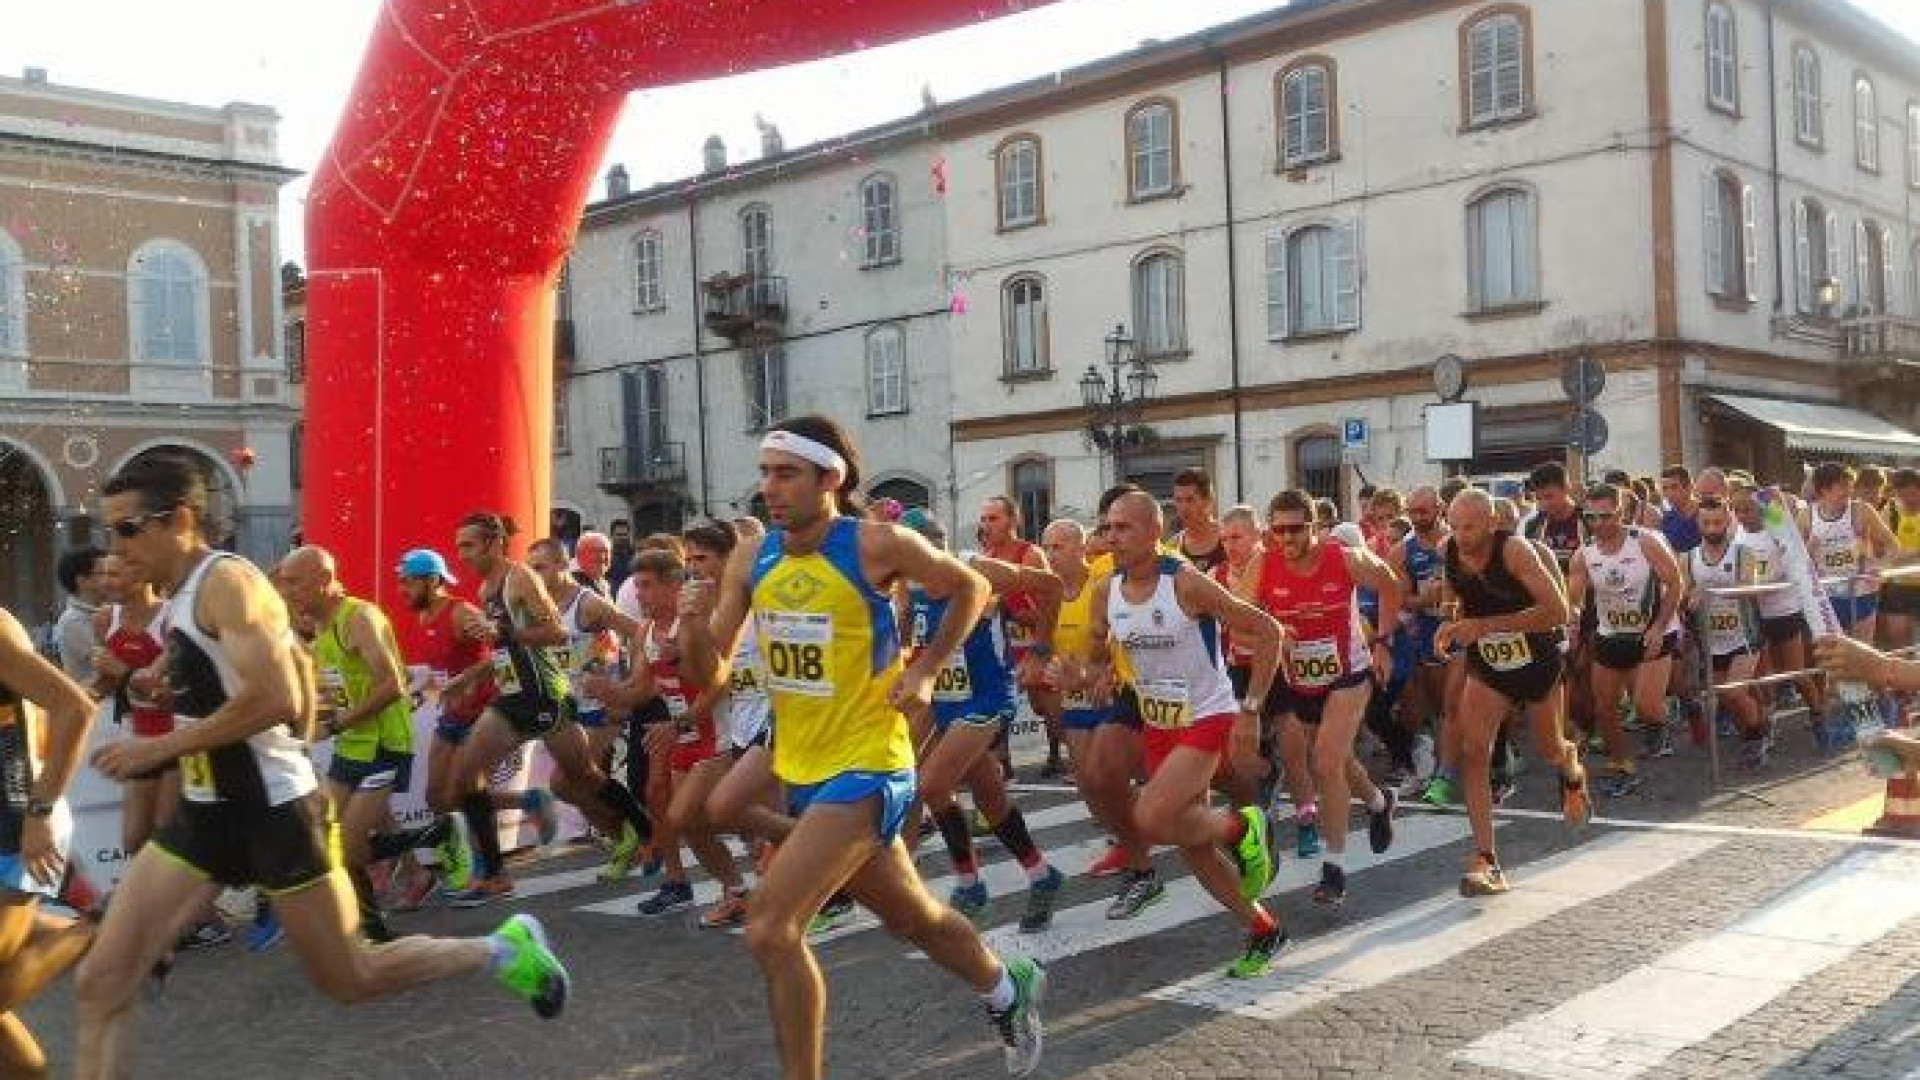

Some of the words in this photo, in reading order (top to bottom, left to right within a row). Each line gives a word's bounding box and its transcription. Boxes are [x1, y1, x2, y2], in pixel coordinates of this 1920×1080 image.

[769, 642, 824, 681] 018
[1483, 641, 1526, 663] 091
[1296, 655, 1339, 679] 006
[1143, 698, 1183, 726] 077
